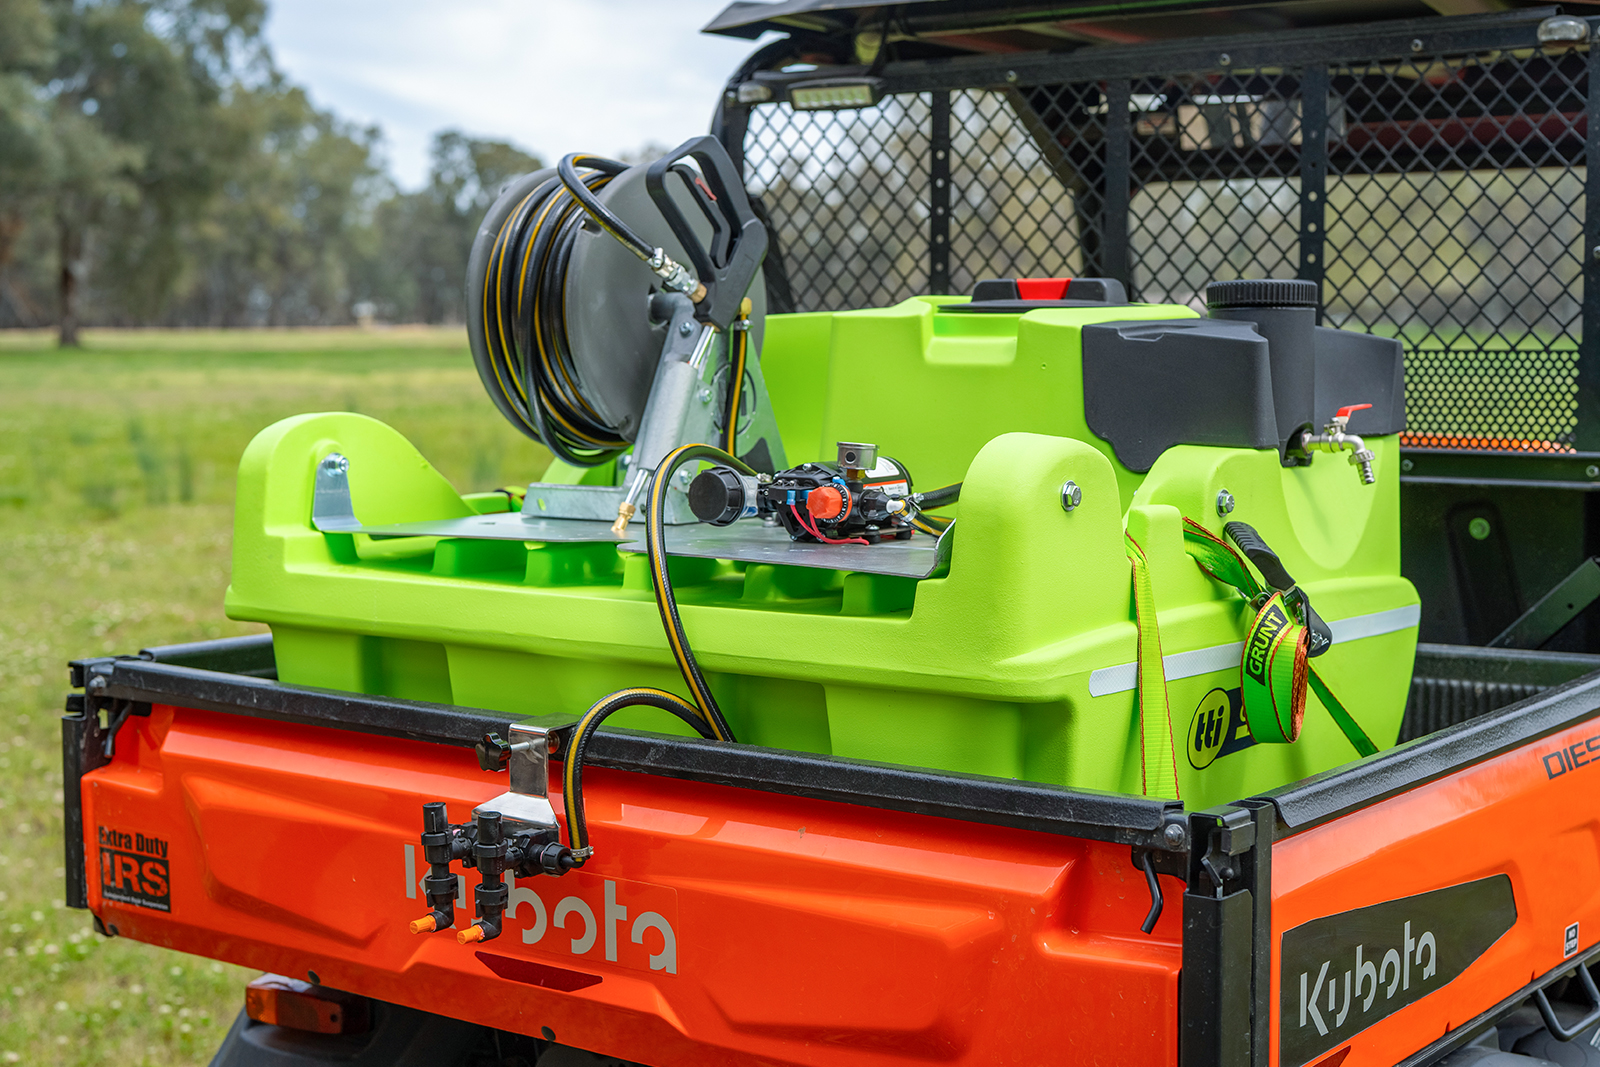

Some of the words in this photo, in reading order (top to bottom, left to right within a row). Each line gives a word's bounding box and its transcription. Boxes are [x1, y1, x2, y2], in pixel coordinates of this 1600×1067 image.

[1249, 611, 1284, 676] GRUNT
[1195, 705, 1225, 752] tti
[1542, 735, 1600, 780] DIES
[98, 826, 132, 849] Extra
[136, 834, 168, 858] Duty
[103, 852, 168, 897] IRS
[1299, 920, 1436, 1037] Kubota
